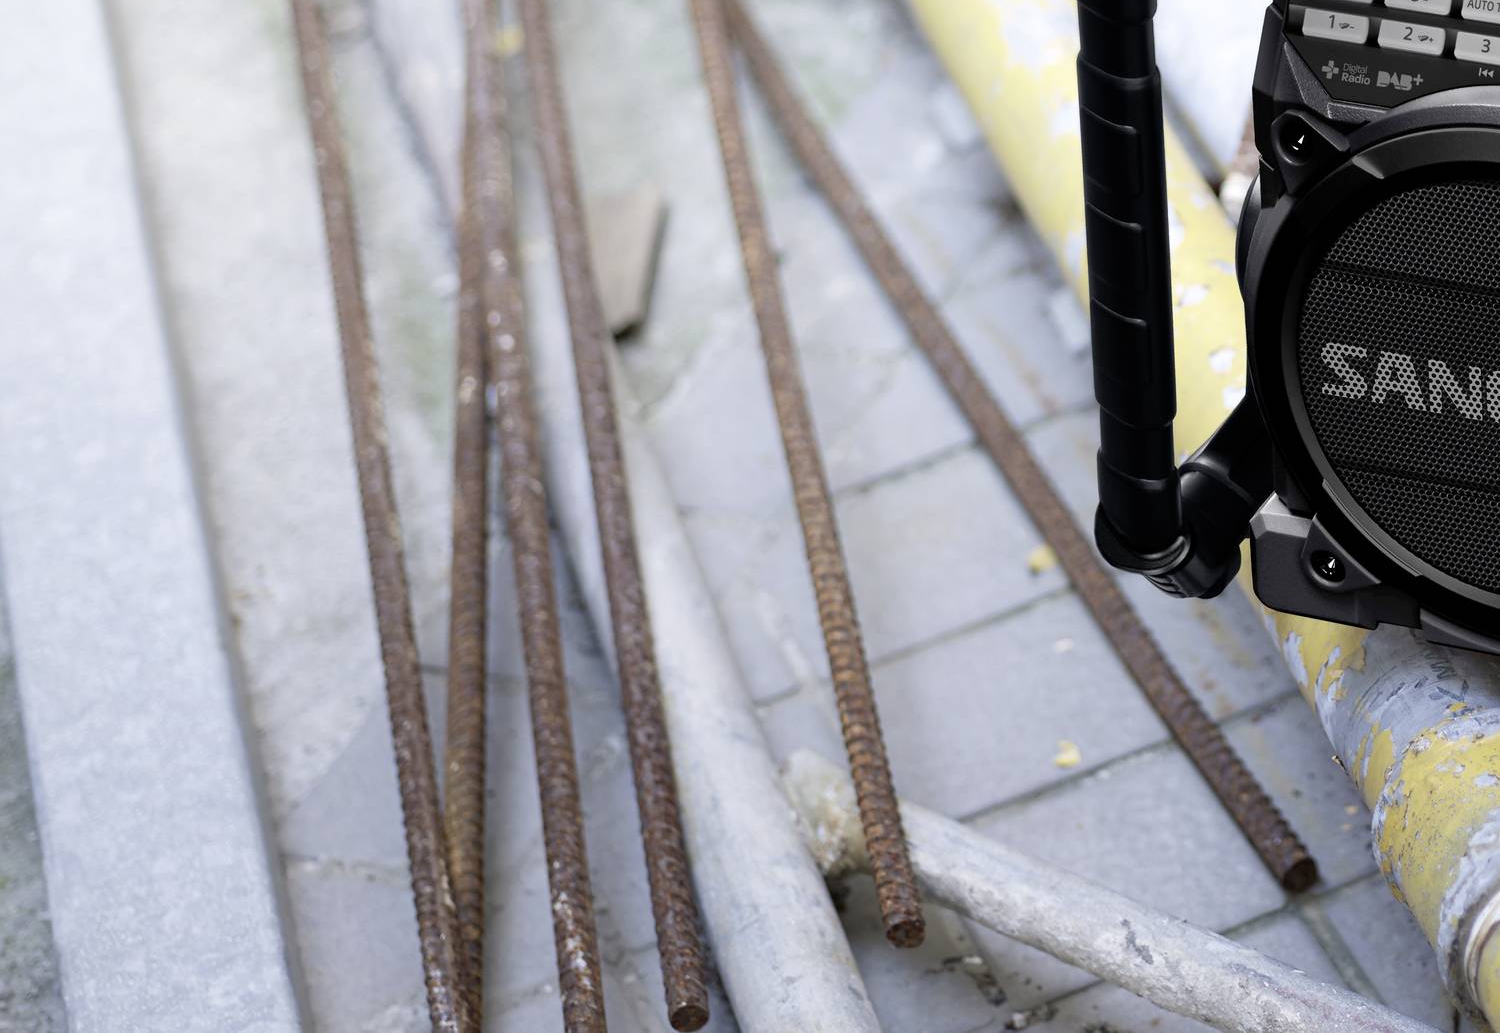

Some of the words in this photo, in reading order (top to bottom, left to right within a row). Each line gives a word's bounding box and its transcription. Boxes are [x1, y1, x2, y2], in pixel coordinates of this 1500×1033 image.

[1481, 39, 1491, 53] 3
[1343, 63, 1368, 74] Digital
[1341, 73, 1371, 85] Radio
